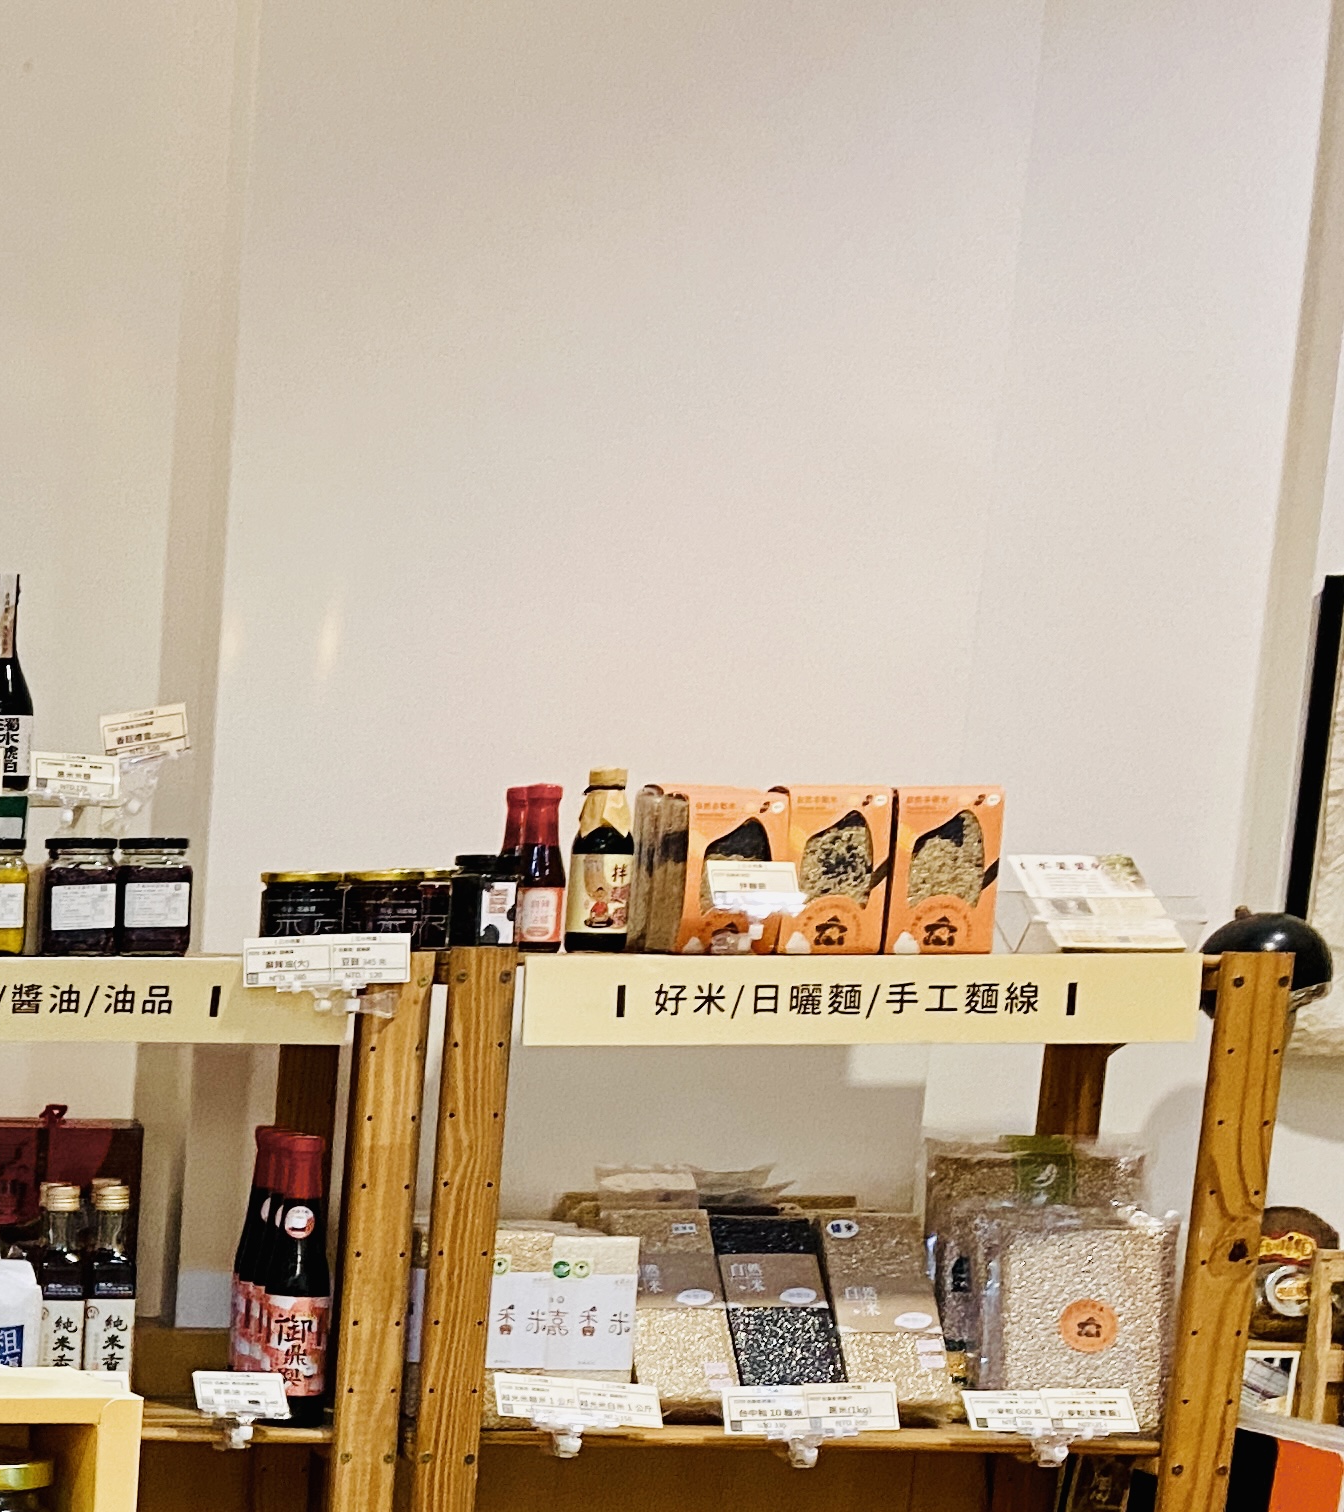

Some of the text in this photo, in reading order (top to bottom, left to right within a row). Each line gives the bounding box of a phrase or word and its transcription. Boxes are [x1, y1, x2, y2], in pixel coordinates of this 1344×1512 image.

[655, 982, 1037, 1018] 好米/日曬麵/手工麵線
